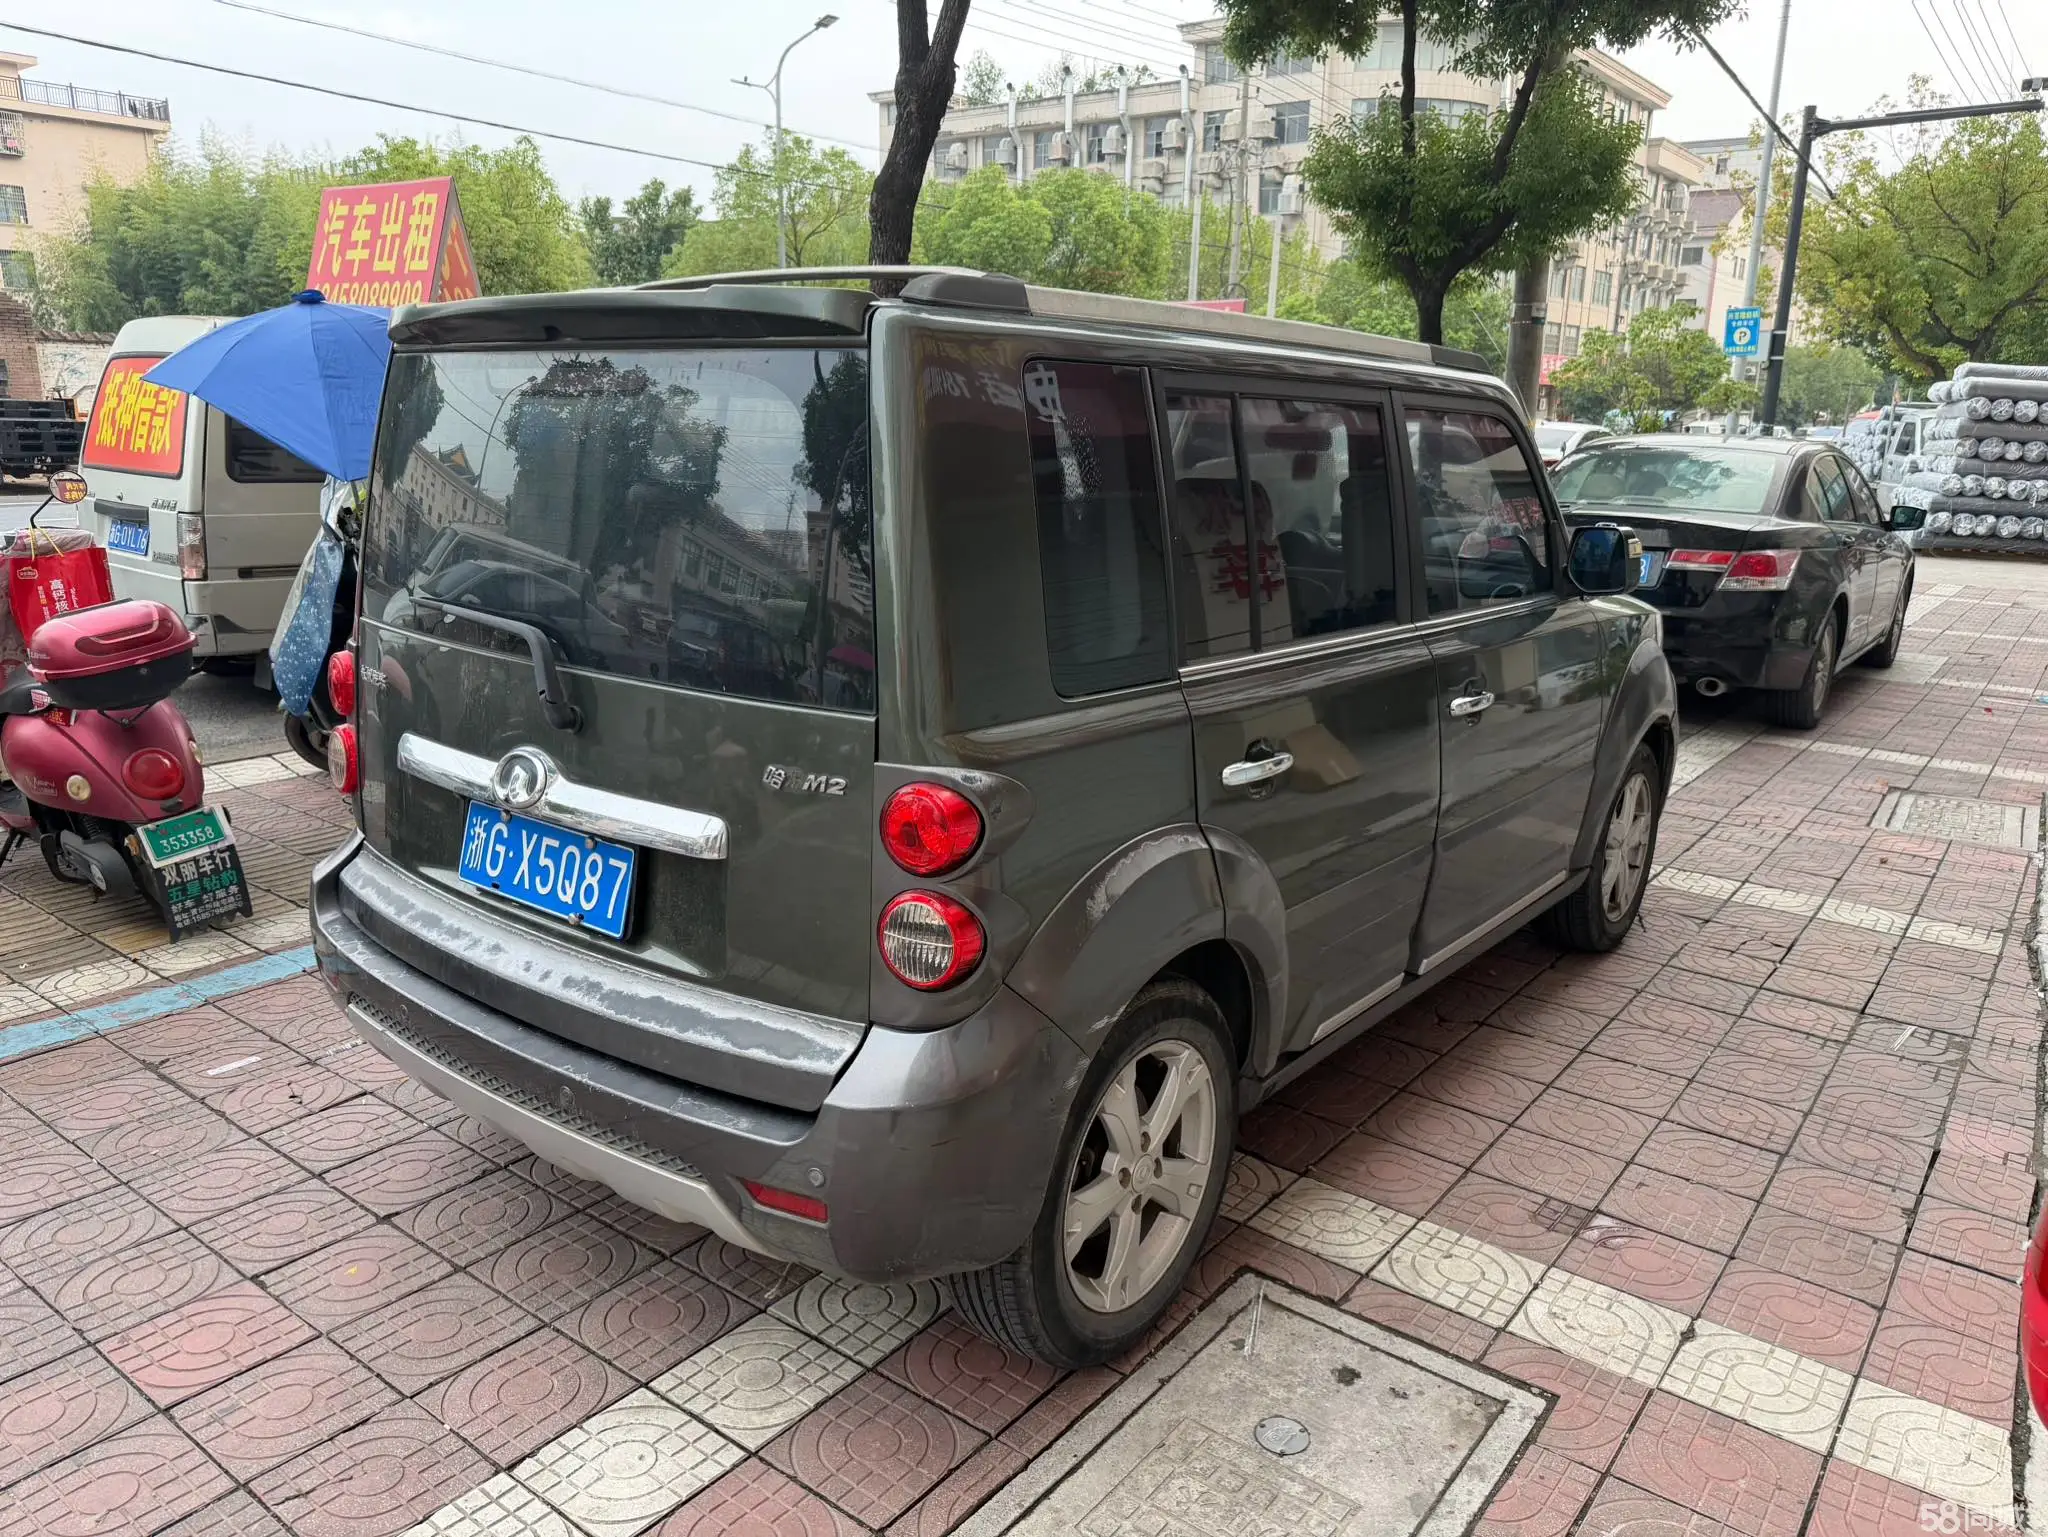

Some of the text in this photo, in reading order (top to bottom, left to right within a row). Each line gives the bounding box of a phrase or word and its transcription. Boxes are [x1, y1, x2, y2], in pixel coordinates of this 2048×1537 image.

[317, 190, 438, 277] 汽车出租
[96, 368, 180, 455] 抵押借款
[49, 579, 70, 613] 高钙核
[802, 774, 847, 795] M2
[160, 826, 215, 853] 353358
[162, 850, 232, 887] 双丽车行
